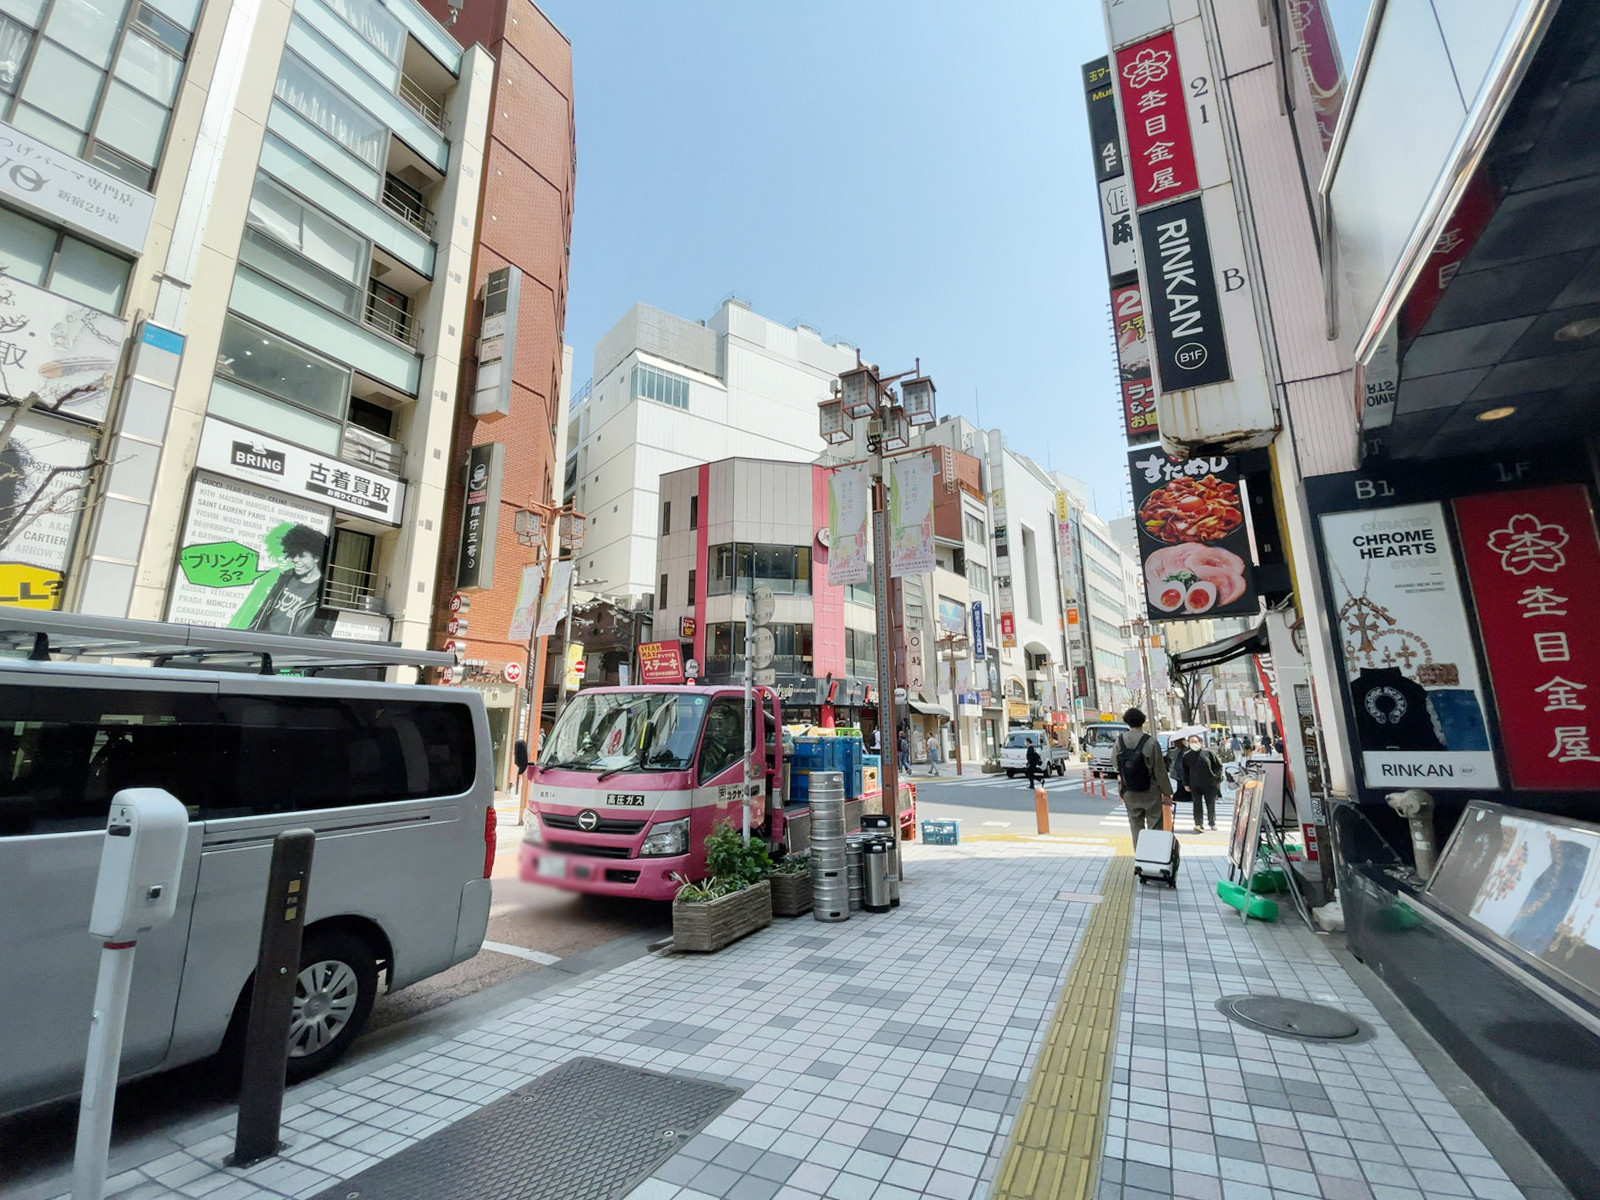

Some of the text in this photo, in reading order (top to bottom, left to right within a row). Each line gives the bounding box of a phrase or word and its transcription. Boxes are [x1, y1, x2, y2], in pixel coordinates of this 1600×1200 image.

[1137, 89, 1182, 194] 杢目金屋
[1156, 217, 1205, 340] RINKAN
[1222, 268, 1246, 292] B
[1180, 350, 1203, 363] B1F
[235, 450, 282, 472] BRING
[202, 477, 223, 489] GUCCI
[310, 462, 391, 503] 古着買取
[1354, 479, 1395, 500] B1
[326, 488, 370, 507] お売りください
[197, 498, 218, 511] SAINT
[218, 503, 247, 518] LAURENT
[248, 511, 267, 522] PARIS
[23, 531, 68, 546] CARTIER
[1352, 528, 1435, 547] CHROME
[1360, 542, 1437, 560] HEARTS
[206, 599, 238, 610] MONCLER
[644, 659, 678, 671] ステーキ
[1517, 585, 1600, 763] 杢目金屋
[1381, 763, 1454, 779] RINKAN
[607, 794, 644, 806] 高圧ガス
